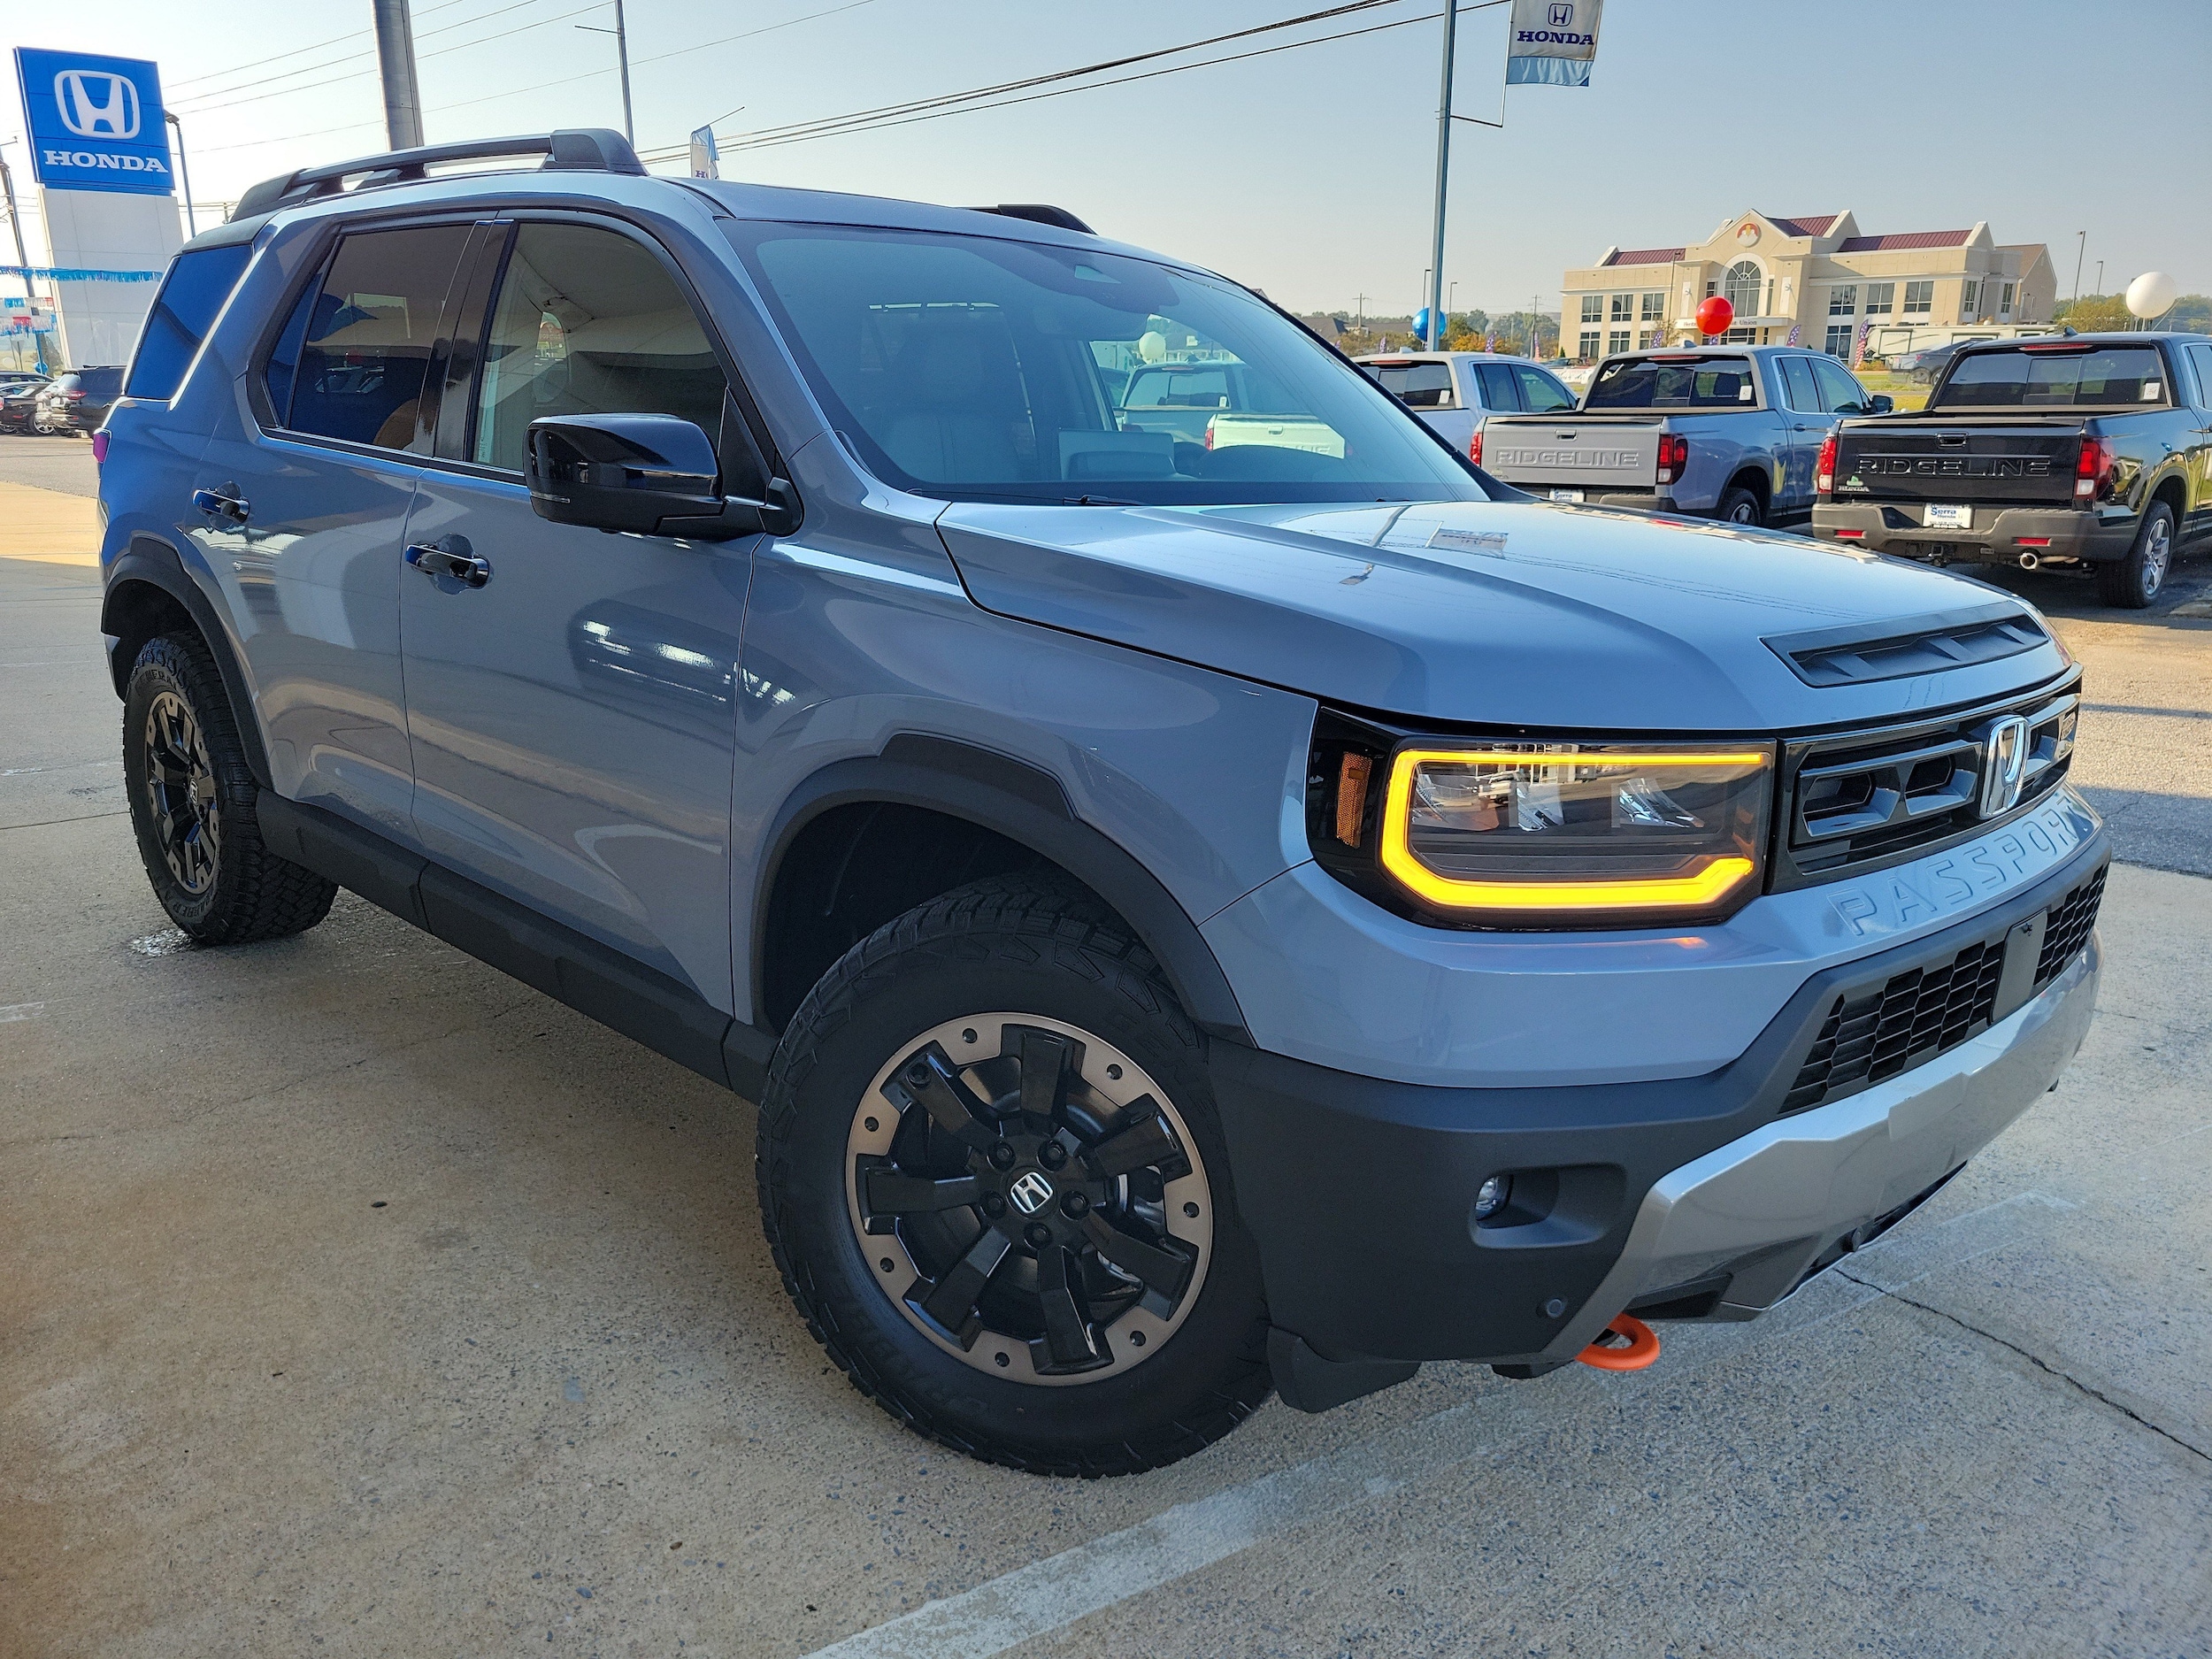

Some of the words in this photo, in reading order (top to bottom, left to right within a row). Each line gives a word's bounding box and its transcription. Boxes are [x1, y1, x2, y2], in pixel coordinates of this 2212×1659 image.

[1517, 30, 1594, 45] HONDA
[43, 150, 169, 174] HONDA
[1495, 449, 1640, 467] RIDGELINE
[1855, 457, 2050, 477] RIDGELINE
[1931, 507, 1956, 516] Serra
[1827, 795, 2085, 937] PASSPORT
